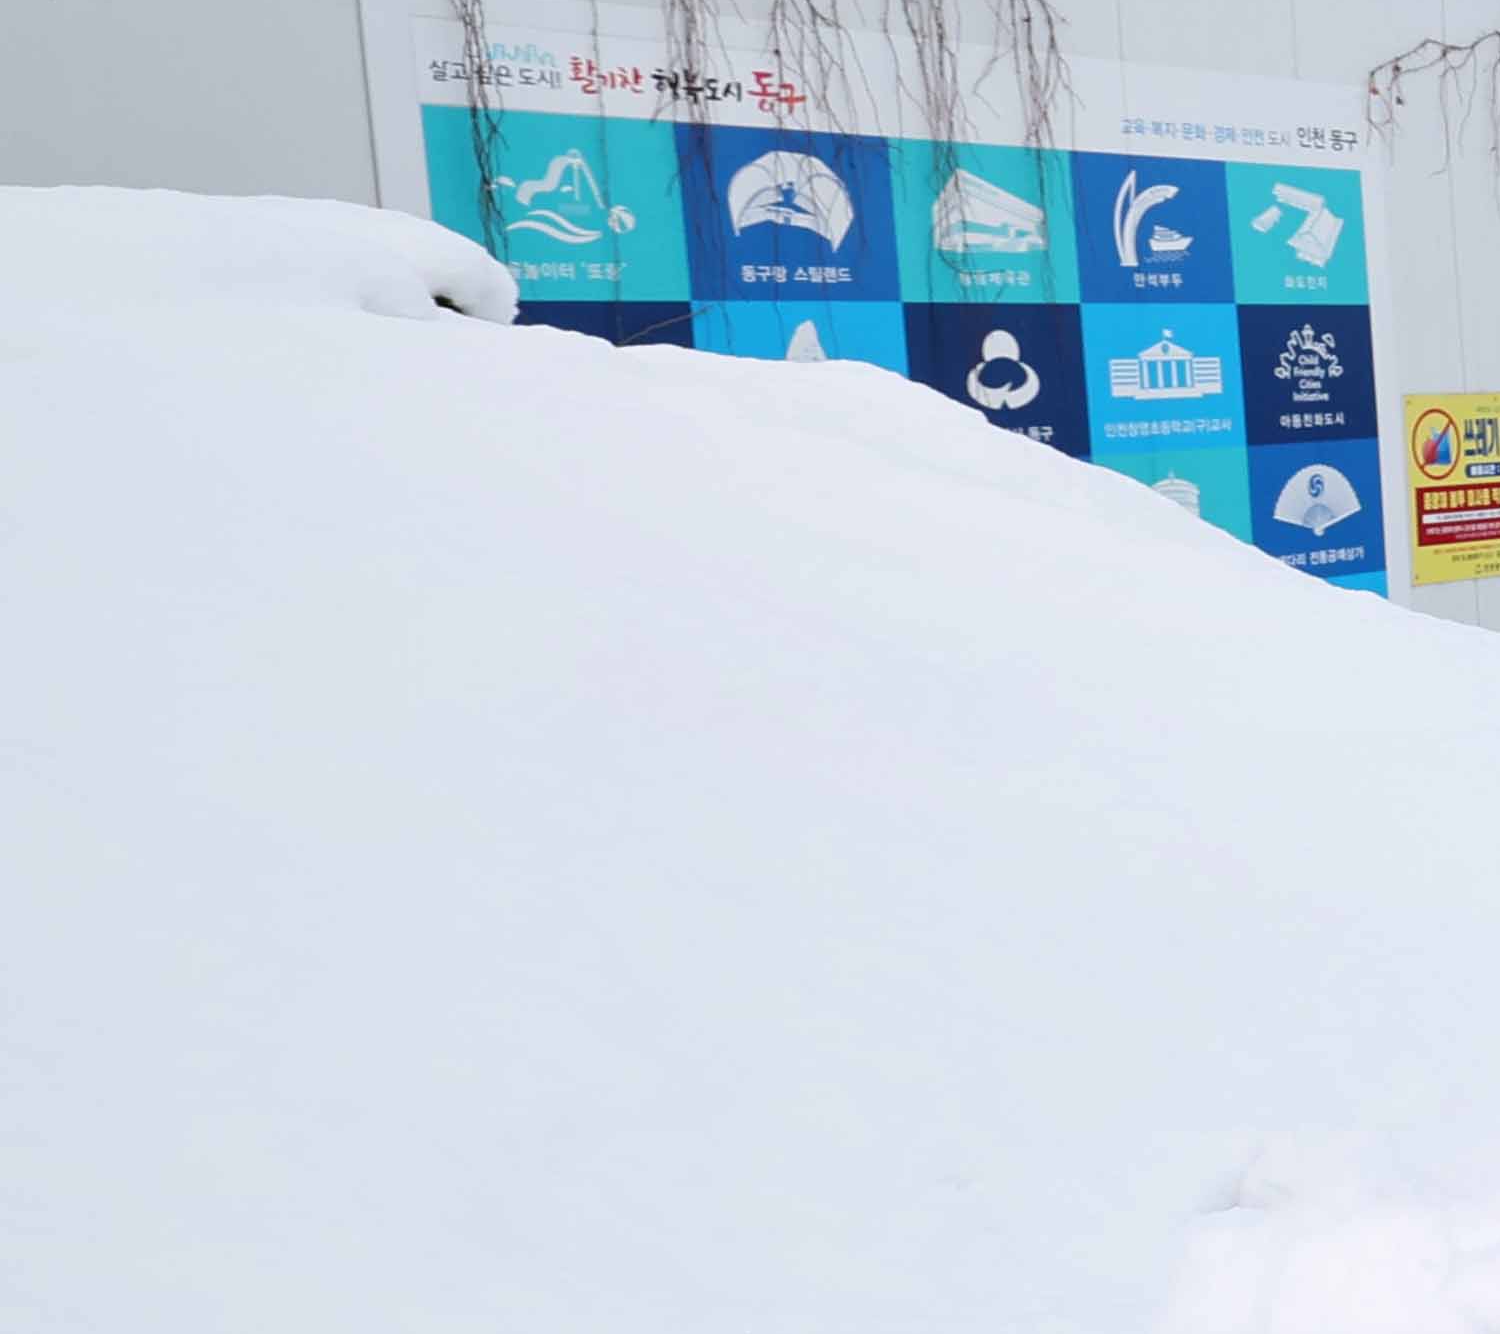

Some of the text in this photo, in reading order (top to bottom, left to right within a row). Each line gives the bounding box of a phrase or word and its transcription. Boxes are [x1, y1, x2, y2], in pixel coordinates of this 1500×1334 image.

[431, 58, 470, 83] 살고
[568, 56, 806, 113] 활기찬 행복도시 동구
[1297, 126, 1326, 149] 인천
[1329, 129, 1358, 152] 동구
[1464, 418, 1500, 457] 쓰레기
